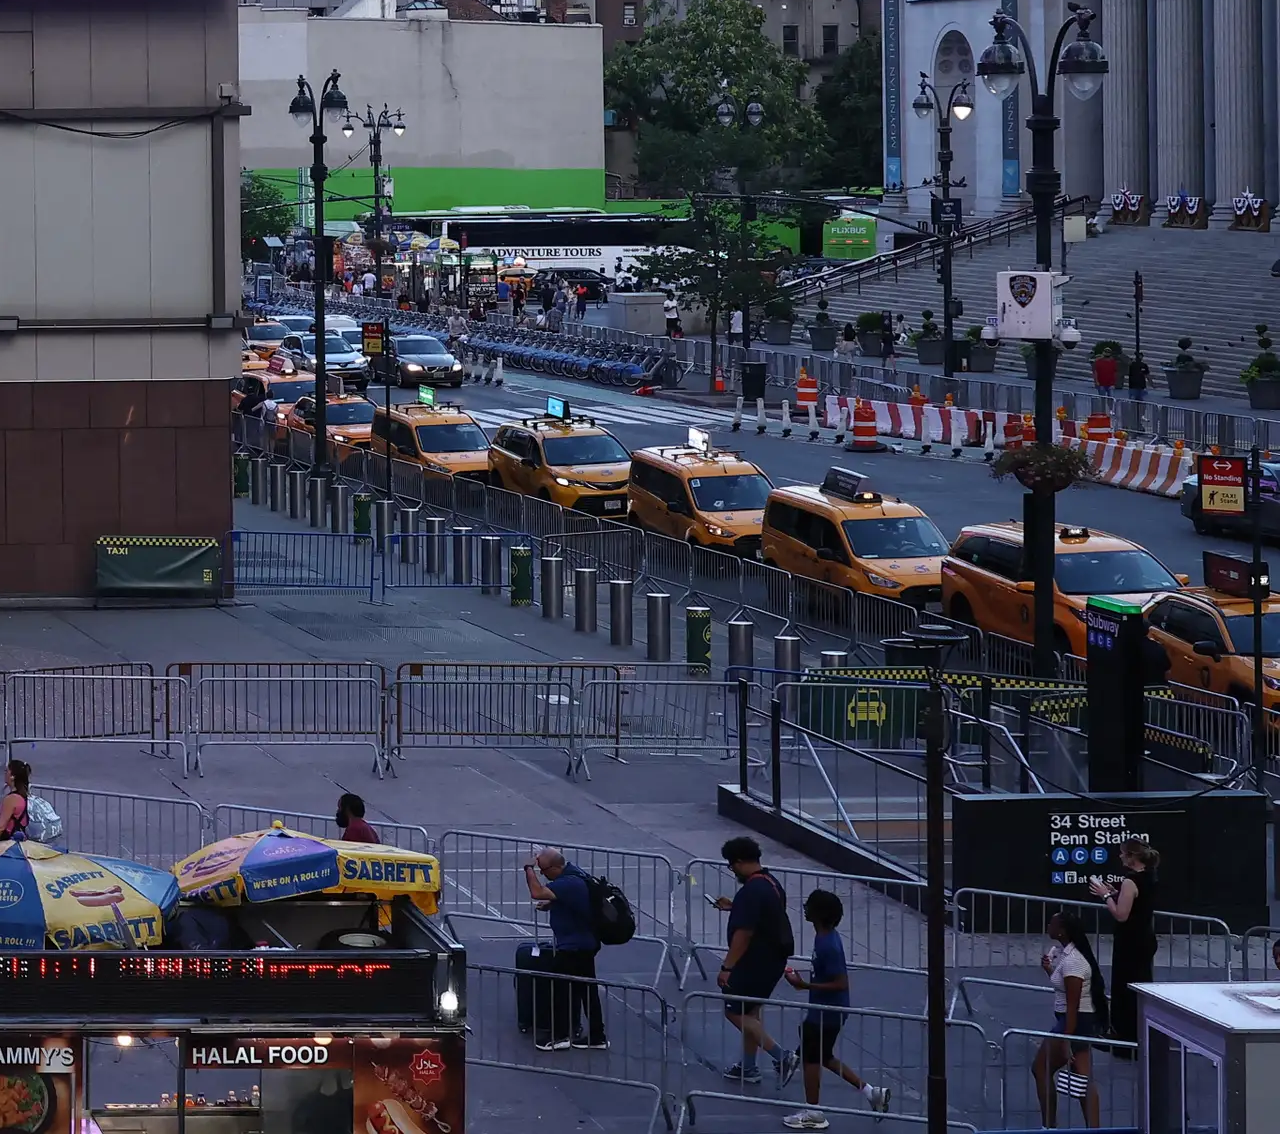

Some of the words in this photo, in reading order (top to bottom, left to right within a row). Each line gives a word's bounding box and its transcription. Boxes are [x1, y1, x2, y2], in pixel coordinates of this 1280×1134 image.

[489, 248, 560, 258] ADVENTURE
[563, 248, 602, 257] TOURS
[1213, 474, 1242, 483] Standing
[106, 547, 128, 555] TAXI
[1088, 612, 1120, 638] Subway
[1050, 712, 1069, 723] AXI
[1050, 815, 1072, 829] 34
[1077, 814, 1126, 829] Street
[1050, 832, 1088, 845] Penn
[1056, 851, 1065, 861] A
[1075, 851, 1085, 861] C
[1095, 850, 1103, 860] E
[341, 859, 433, 883] SABRETT
[45, 870, 105, 899] SABRETT
[253, 878, 277, 890] WE'RE
[279, 876, 292, 885] ON
[292, 875, 299, 883] A
[300, 871, 320, 882] ROLL
[321, 868, 331, 878] !!!
[1078, 875, 1088, 884] at
[55, 916, 160, 950] SABRTT
[3, 937, 24, 946] ROLL
[25, 938, 36, 947] !!!
[192, 1046, 264, 1066] HALAL
[268, 1045, 329, 1064] FOOD
